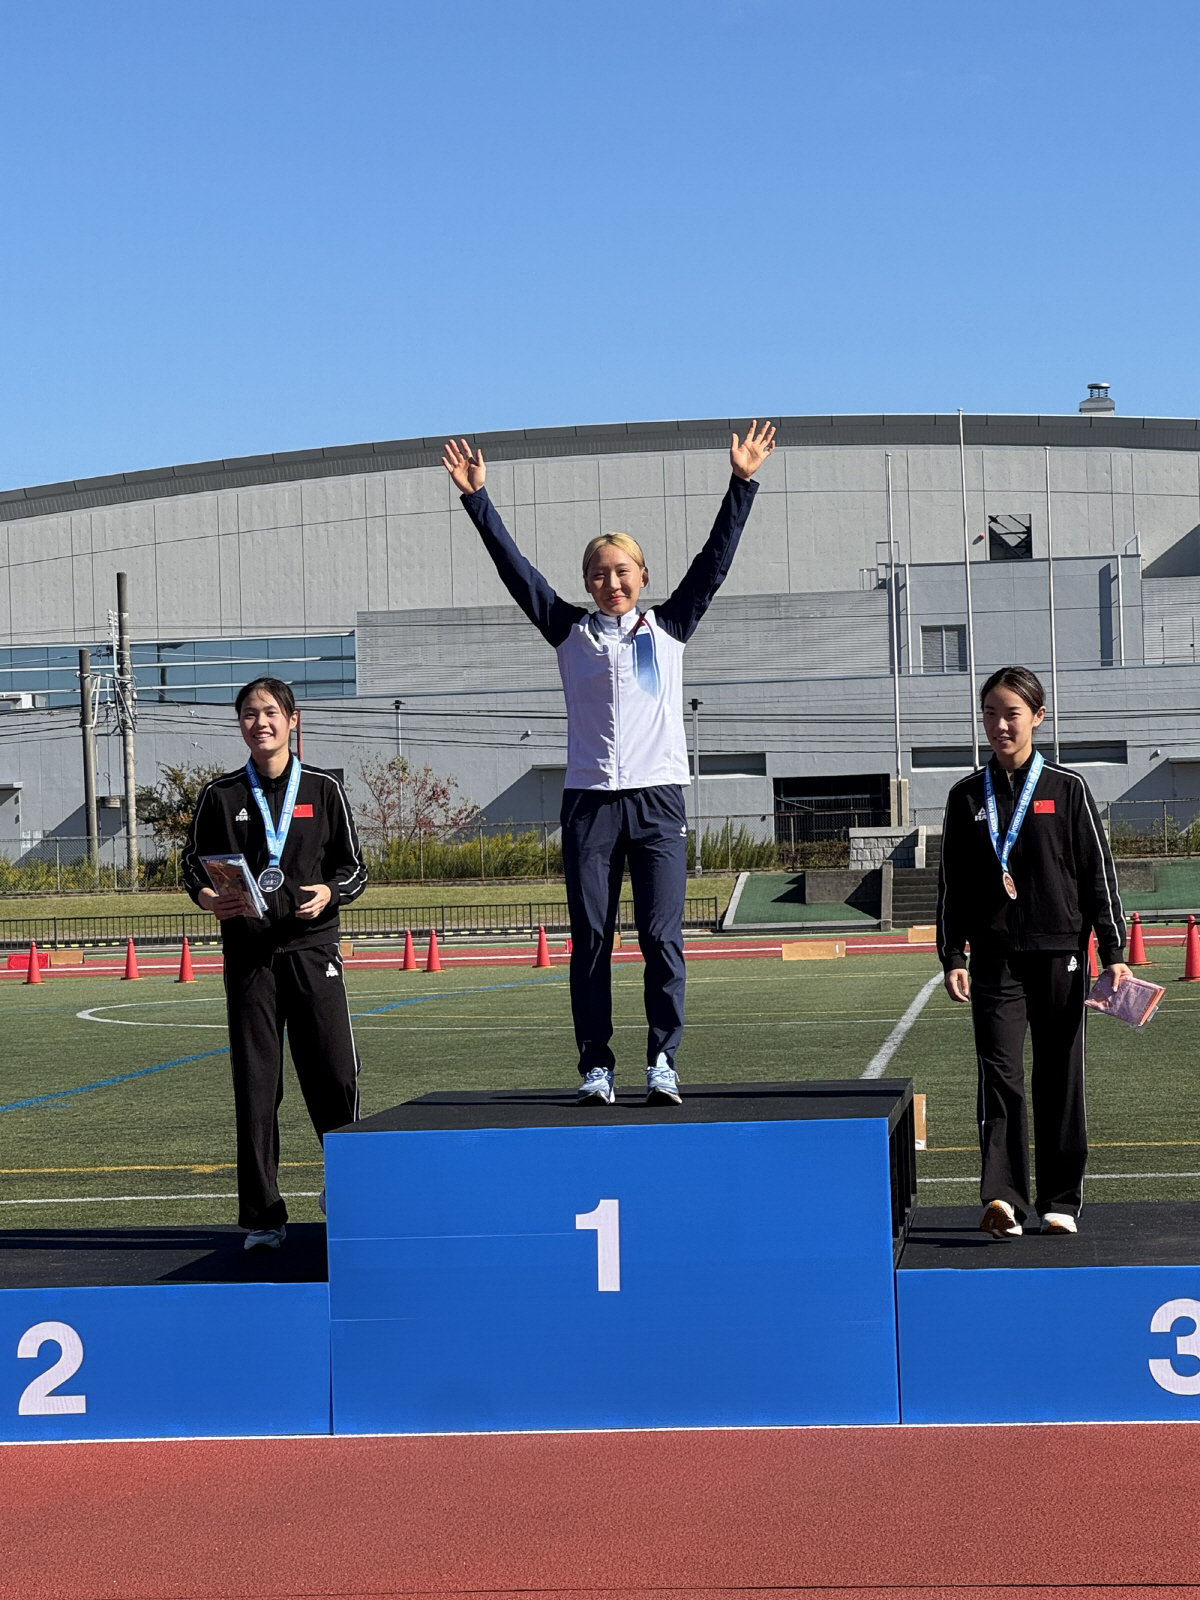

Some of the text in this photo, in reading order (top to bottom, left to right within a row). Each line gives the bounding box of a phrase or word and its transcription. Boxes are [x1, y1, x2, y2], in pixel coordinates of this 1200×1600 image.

[575, 1199, 620, 1291] 1
[17, 1321, 86, 1416] 2
[1148, 1298, 1200, 1395] 3
